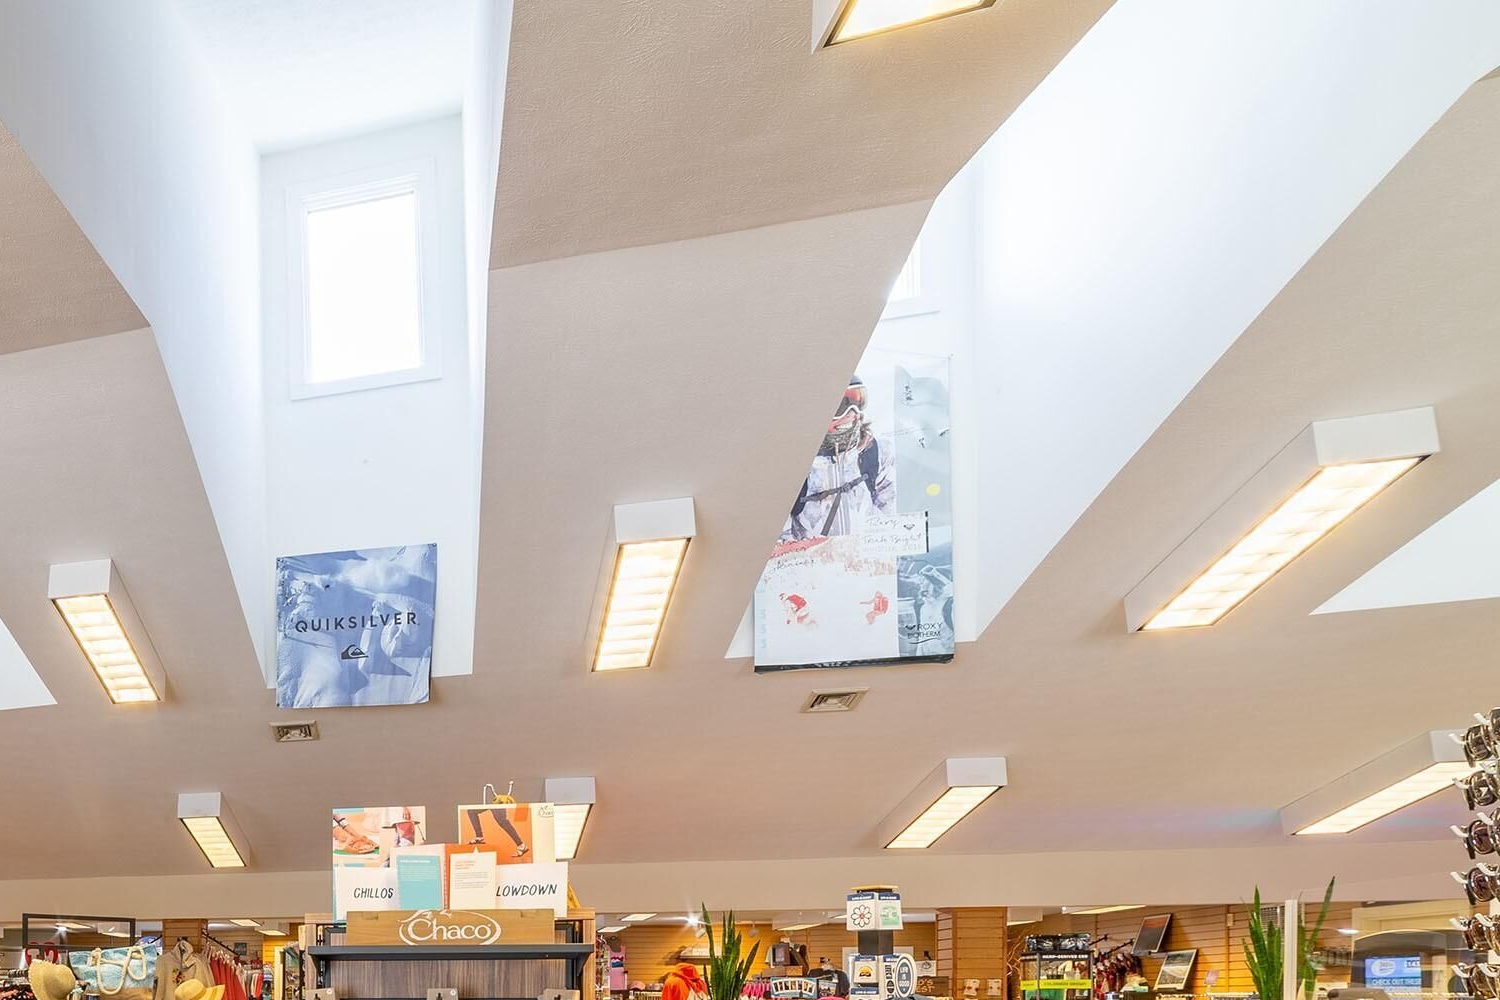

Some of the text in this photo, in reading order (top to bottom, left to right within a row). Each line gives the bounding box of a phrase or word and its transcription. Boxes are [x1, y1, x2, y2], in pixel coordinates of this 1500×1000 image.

[295, 612, 417, 633] QUIKSILVER
[917, 622, 942, 631] ROXY
[353, 886, 394, 899] CHILLOS
[496, 883, 558, 898] LOWDOWN
[407, 918, 490, 941] Chaco
